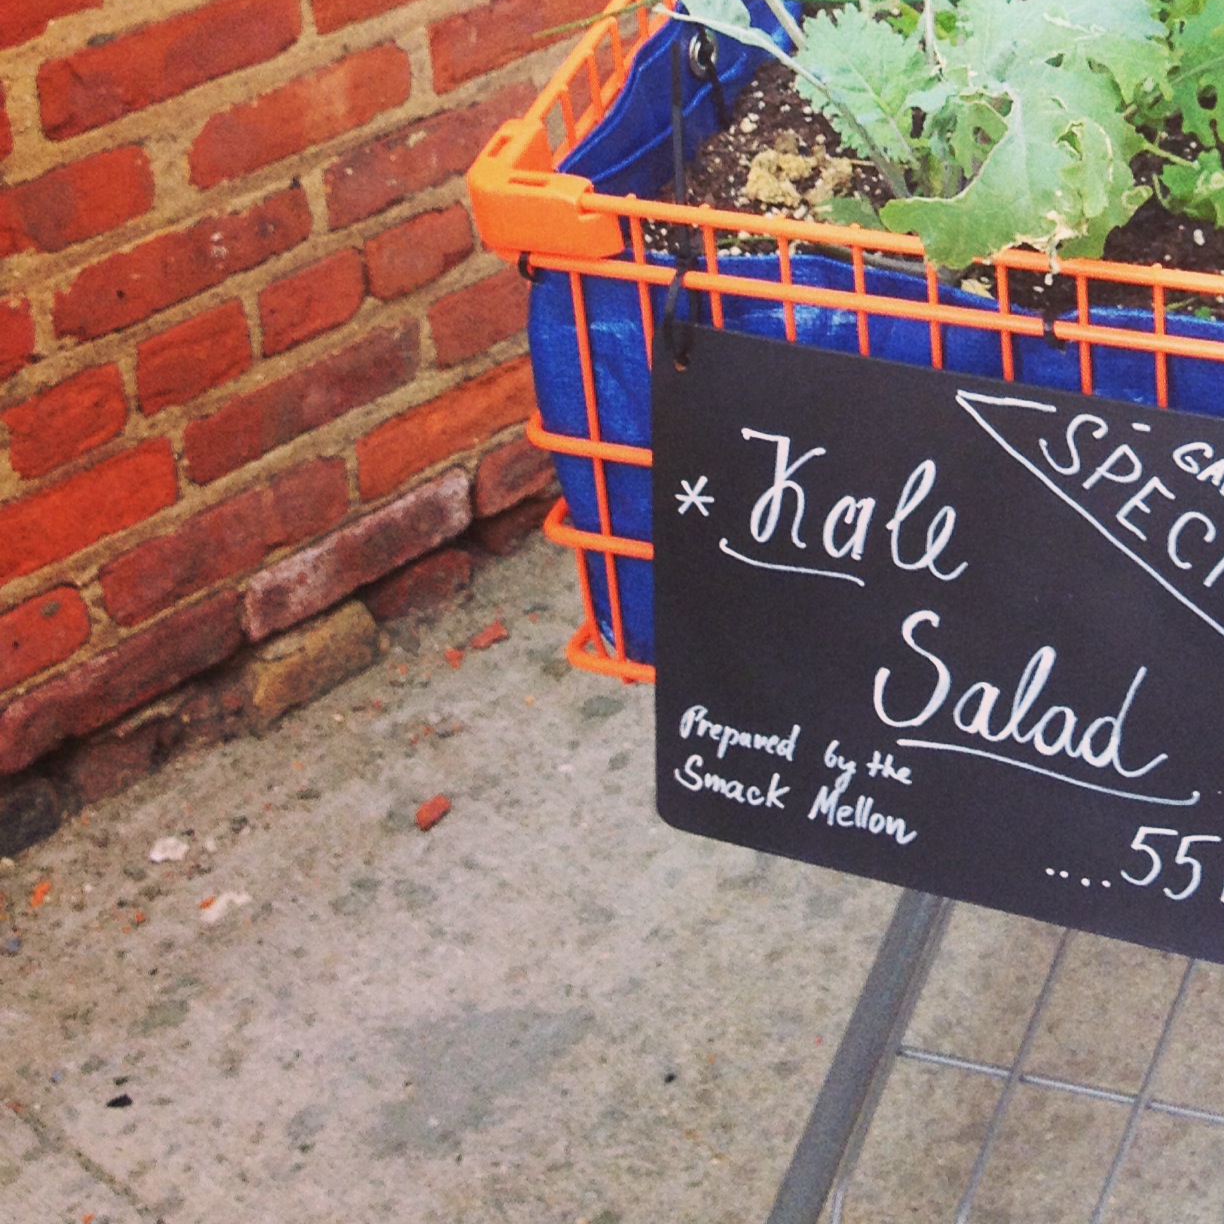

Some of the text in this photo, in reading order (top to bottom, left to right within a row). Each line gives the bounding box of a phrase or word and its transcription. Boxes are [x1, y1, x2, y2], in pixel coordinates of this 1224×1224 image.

[740, 427, 969, 581] Kale
[679, 704, 913, 794] Prepared by the
[872, 609, 1169, 778] Salad
[673, 754, 918, 845] Smack Mellon
